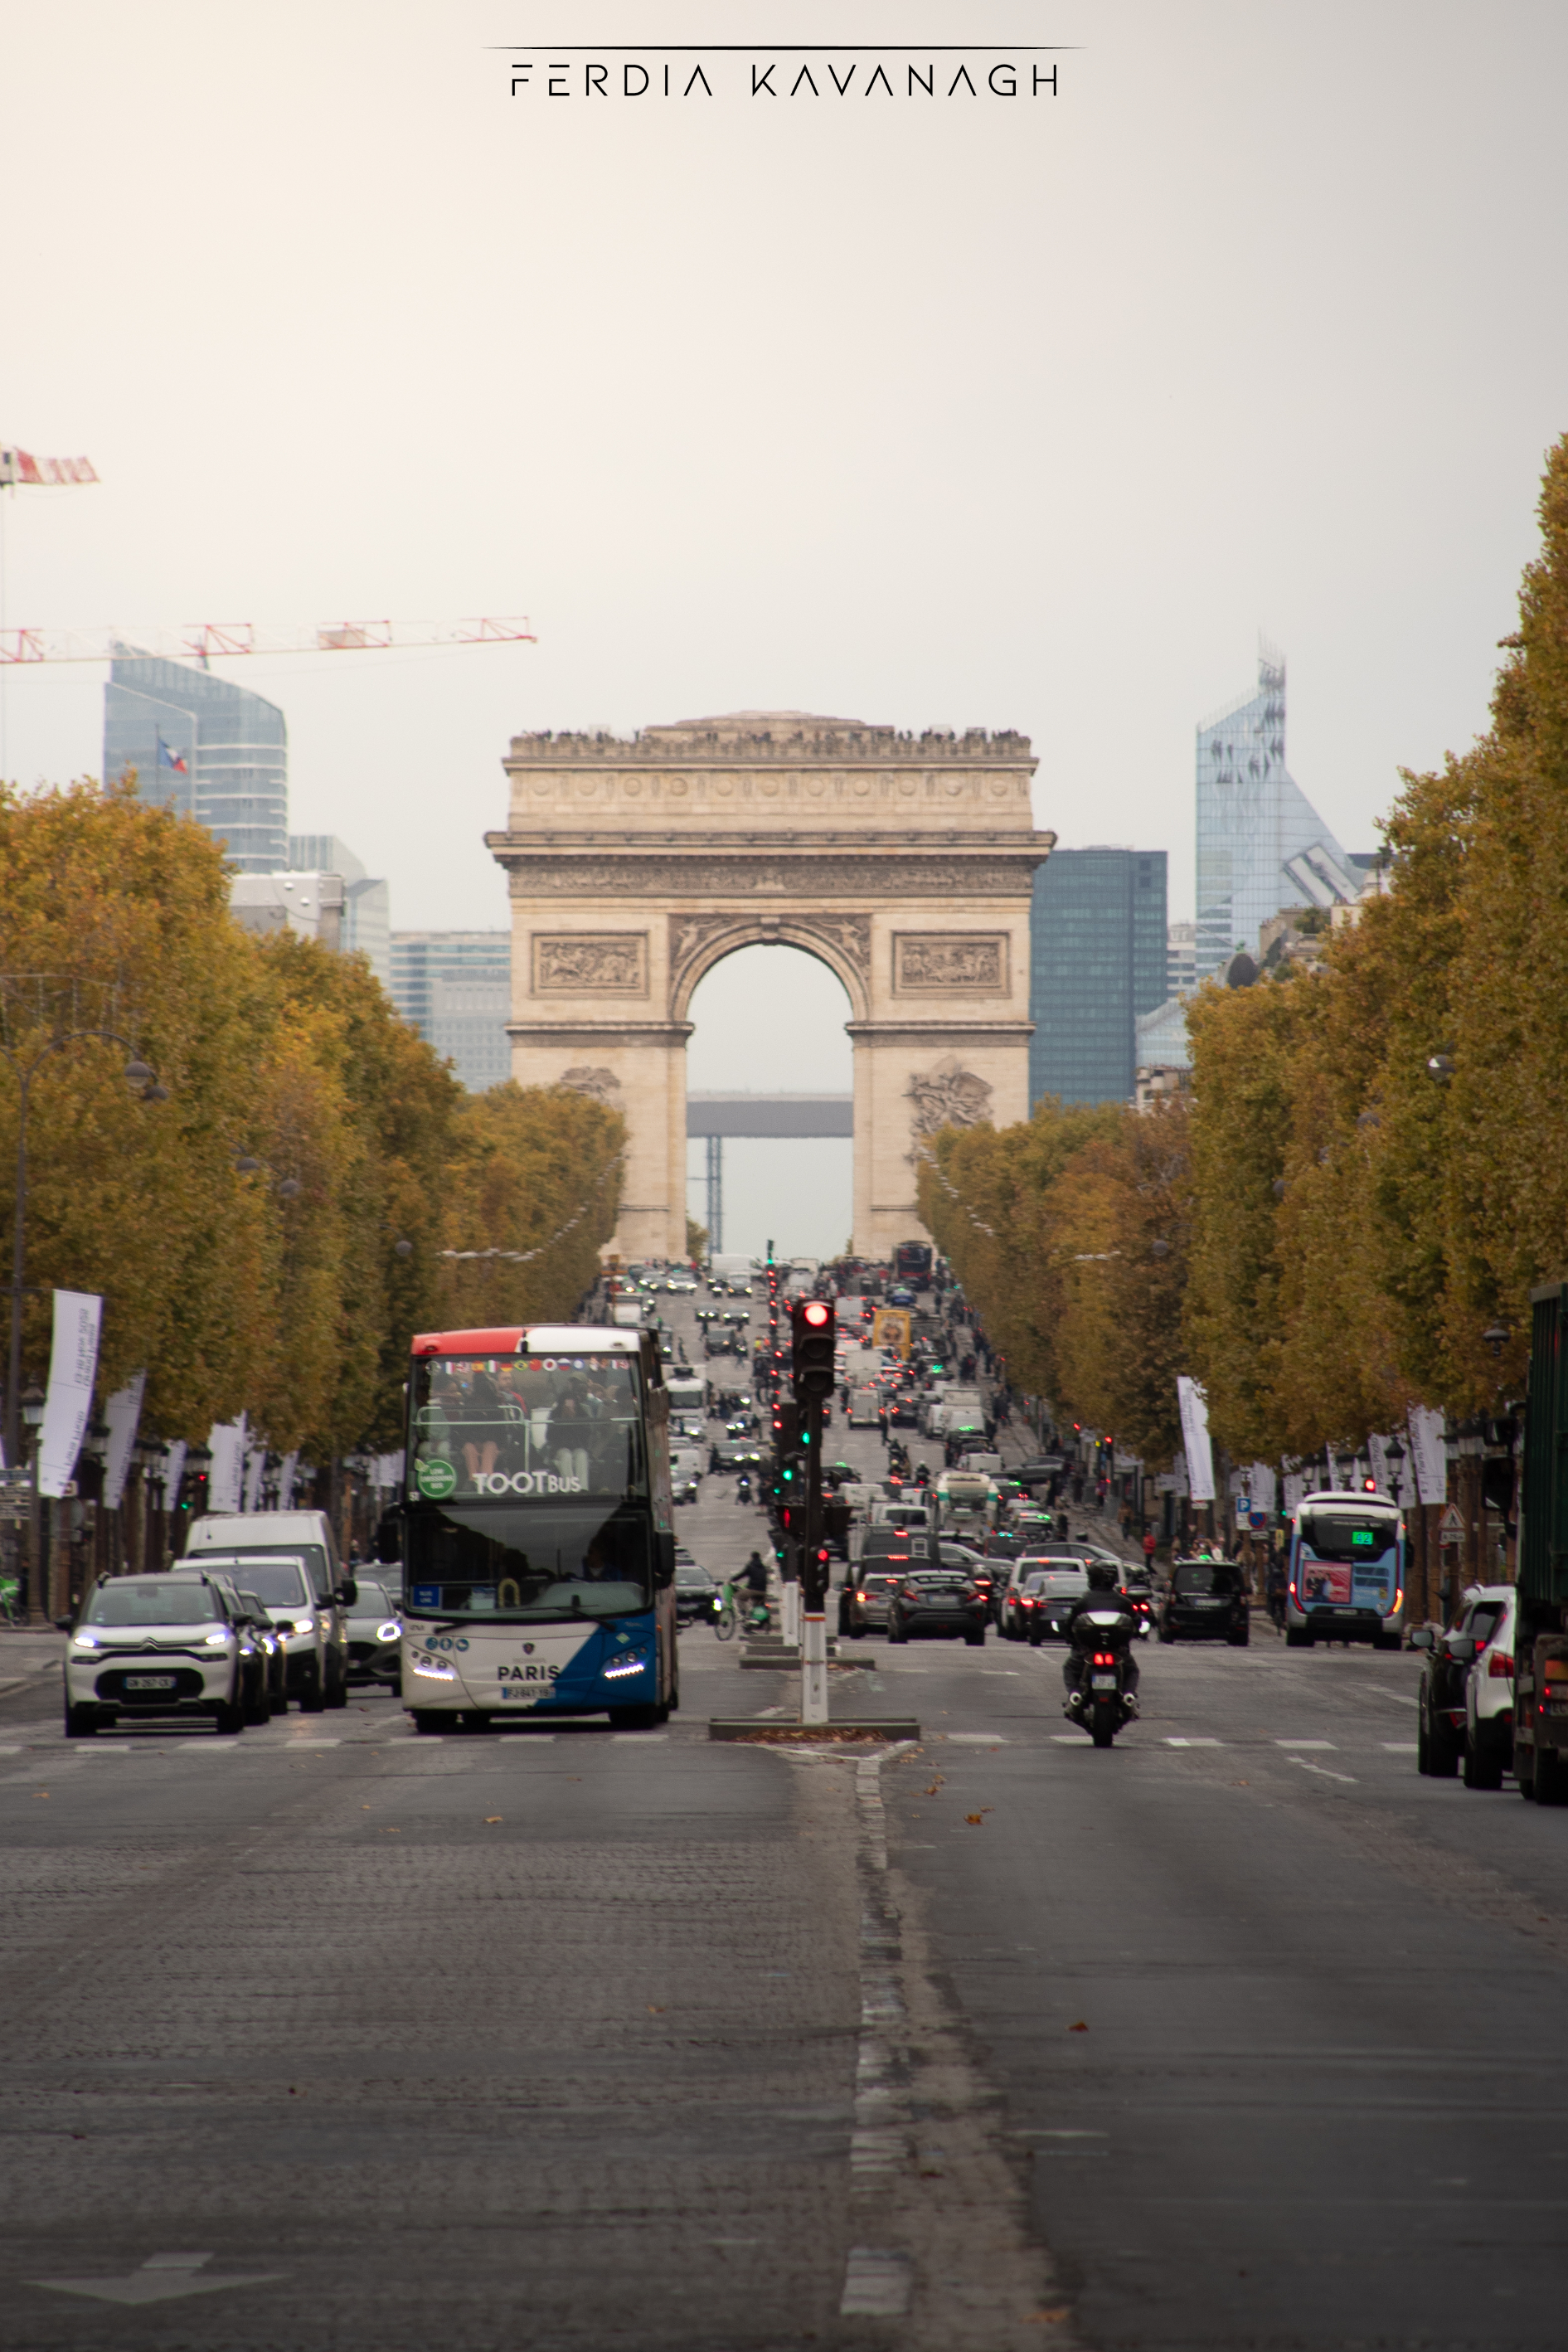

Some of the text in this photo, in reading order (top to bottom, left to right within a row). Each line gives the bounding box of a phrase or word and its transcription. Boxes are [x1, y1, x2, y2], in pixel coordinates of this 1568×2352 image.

[1240, 1499, 1249, 1511] P
[1356, 1533, 1370, 1543] 42
[498, 1665, 561, 1681] PARIS
